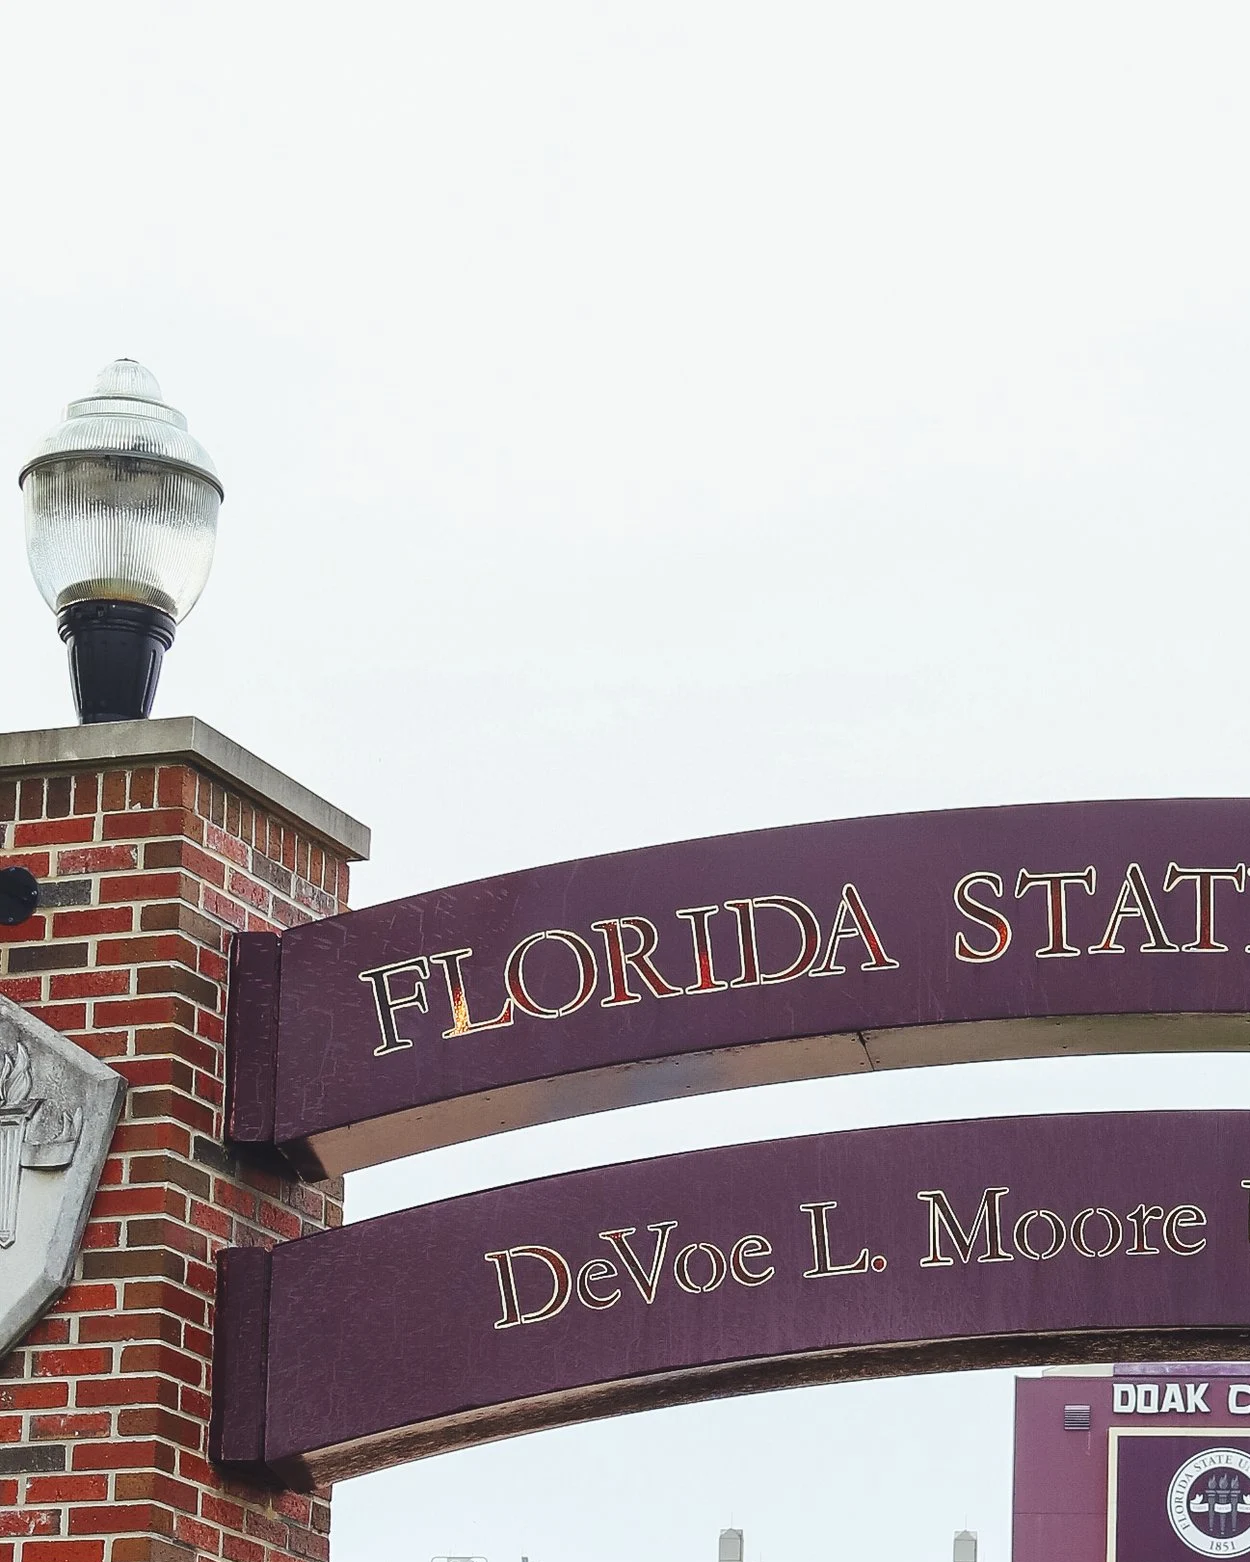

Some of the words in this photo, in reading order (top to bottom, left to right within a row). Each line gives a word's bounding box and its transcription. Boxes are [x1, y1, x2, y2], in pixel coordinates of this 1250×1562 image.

[360, 883, 899, 1057] FLORIDA
[485, 1220, 775, 1330] DeVoe
[800, 1201, 888, 1279] L.
[917, 1186, 1207, 1268] Moore
[1112, 1383, 1211, 1414] DOAK
[1174, 1472, 1194, 1531] FLORIDA
[1193, 1454, 1234, 1473] STATE
[1209, 1541, 1237, 1552] 1851
